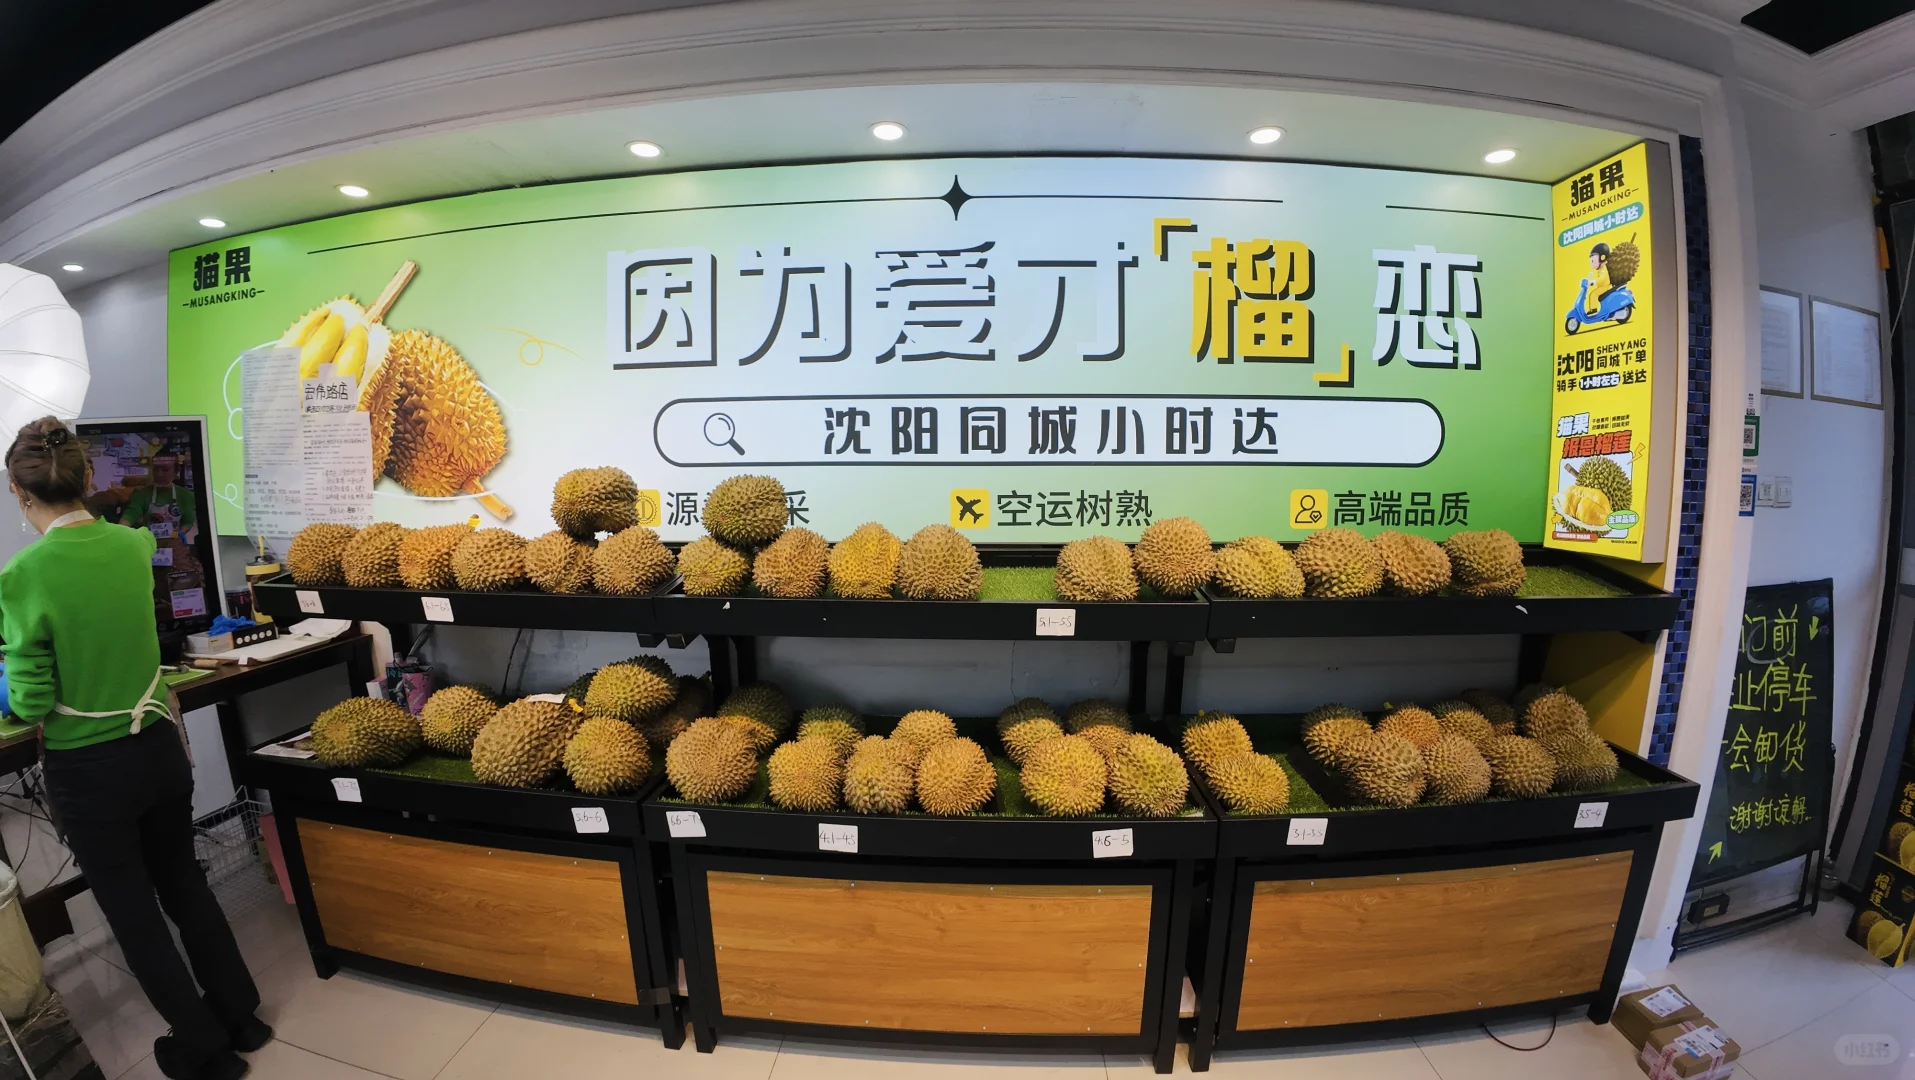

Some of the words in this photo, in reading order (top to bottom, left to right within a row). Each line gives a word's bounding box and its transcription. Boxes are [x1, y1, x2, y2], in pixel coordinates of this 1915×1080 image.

[1570, 159, 1625, 207] 猫果
[1569, 189, 1631, 221] MUSANGKING
[1563, 205, 1640, 245] 沈阳同城小时达
[193, 246, 251, 291] 猫果
[189, 287, 257, 309] MUSANGKING
[1557, 348, 1594, 376] 沈阳
[1597, 338, 1647, 355] SHENYANG
[1597, 350, 1647, 370] 同城下单
[824, 405, 1278, 455] 沈阳同城小时达
[1557, 412, 1590, 437] 猫果
[1562, 430, 1632, 458] 报恩榴莲
[997, 490, 1153, 528] 空运树熟
[1333, 490, 1470, 528] 高端品质
[1728, 657, 1817, 716] 止停车
